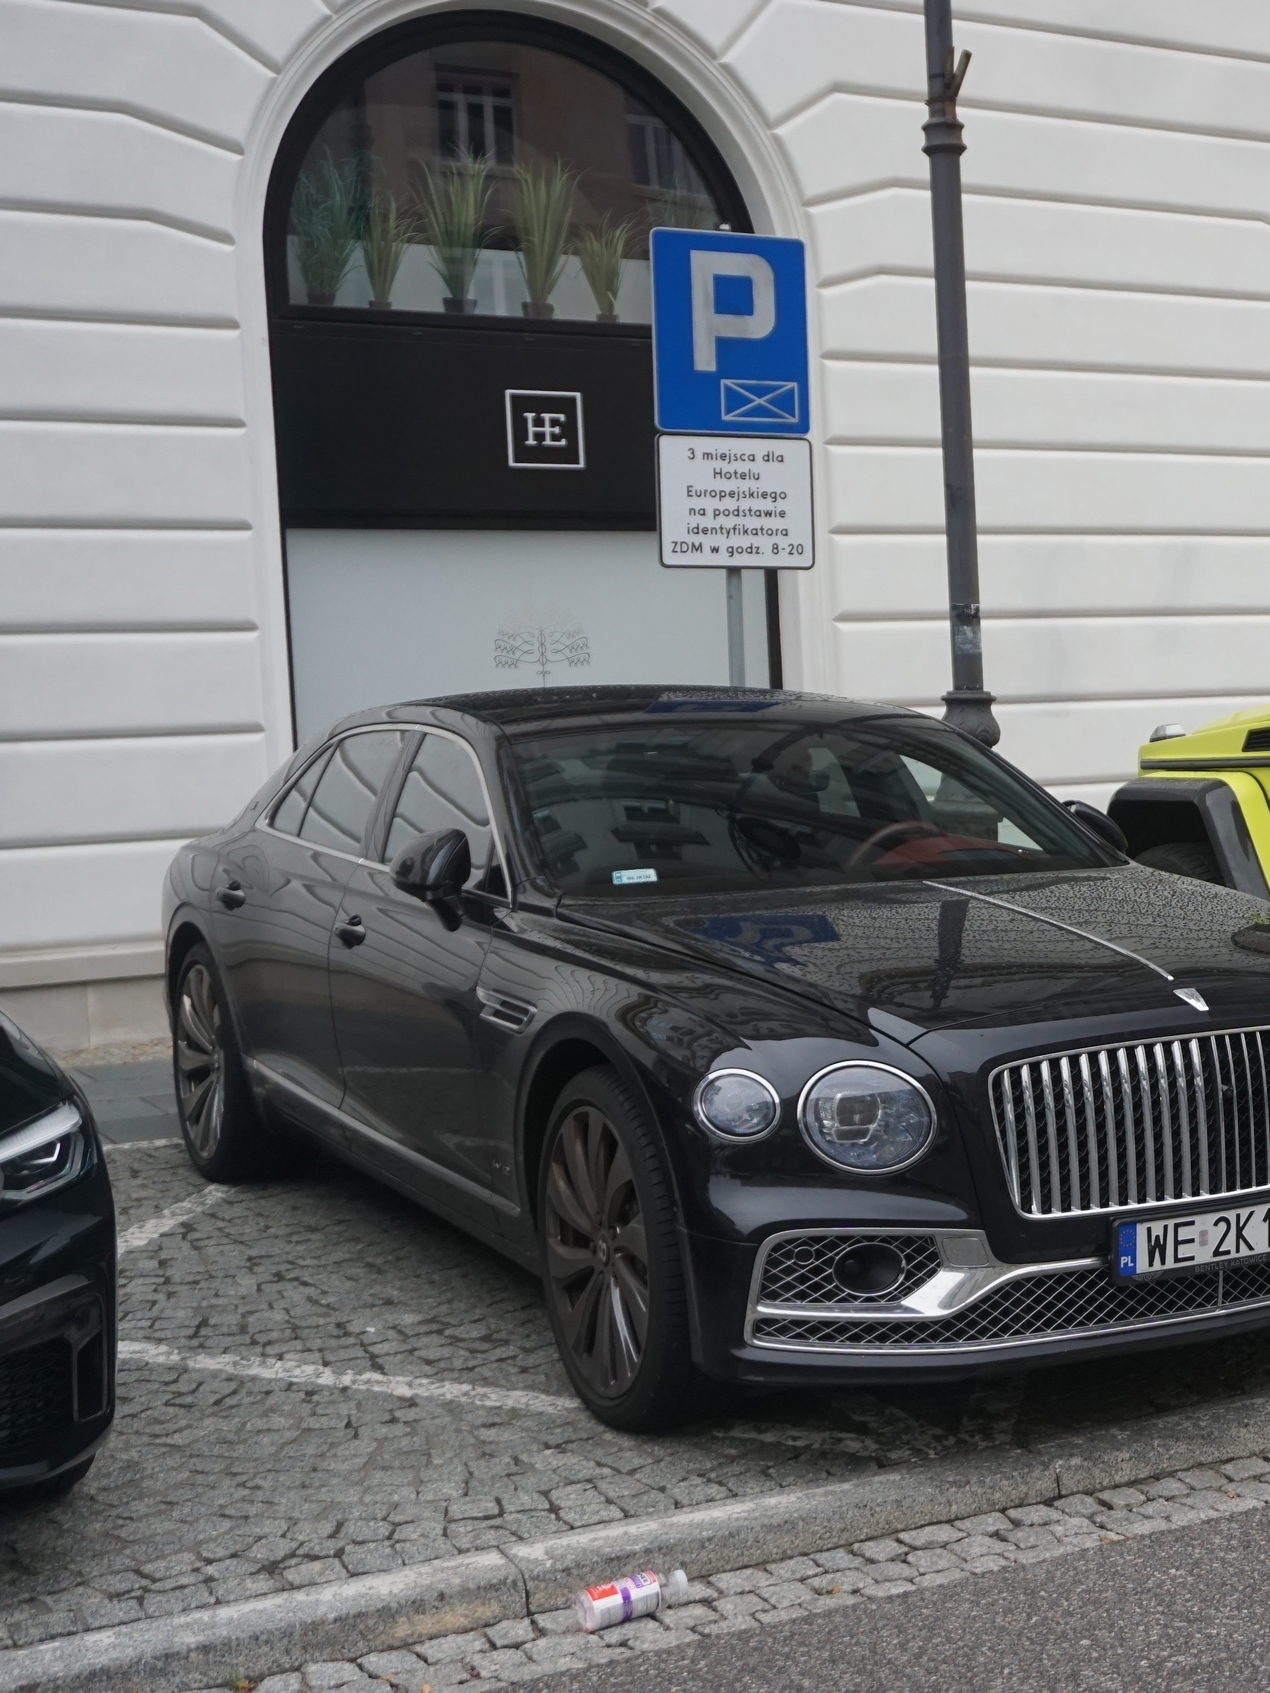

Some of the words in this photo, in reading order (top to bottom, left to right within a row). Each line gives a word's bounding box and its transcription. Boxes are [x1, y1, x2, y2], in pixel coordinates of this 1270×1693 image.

[690, 249, 776, 371] P
[523, 412, 567, 446] HE
[687, 447, 695, 460] 3
[702, 449, 756, 464] miejsca
[762, 450, 784, 463] dla
[713, 467, 760, 480] Hotelu
[686, 485, 787, 503] Europejskiego
[689, 507, 706, 516] na
[713, 505, 786, 520] podstawie
[687, 523, 789, 539] identyfikatora
[671, 541, 703, 554] ZDM
[710, 545, 720, 554] w
[726, 543, 764, 558] godz.
[771, 542, 804, 556] 8-20
[1146, 1220, 1195, 1267] WE
[1120, 1256, 1134, 1268] PL
[1194, 1261, 1229, 1273] BENTLEY
[1230, 1253, 1267, 1267] KATOWICE
